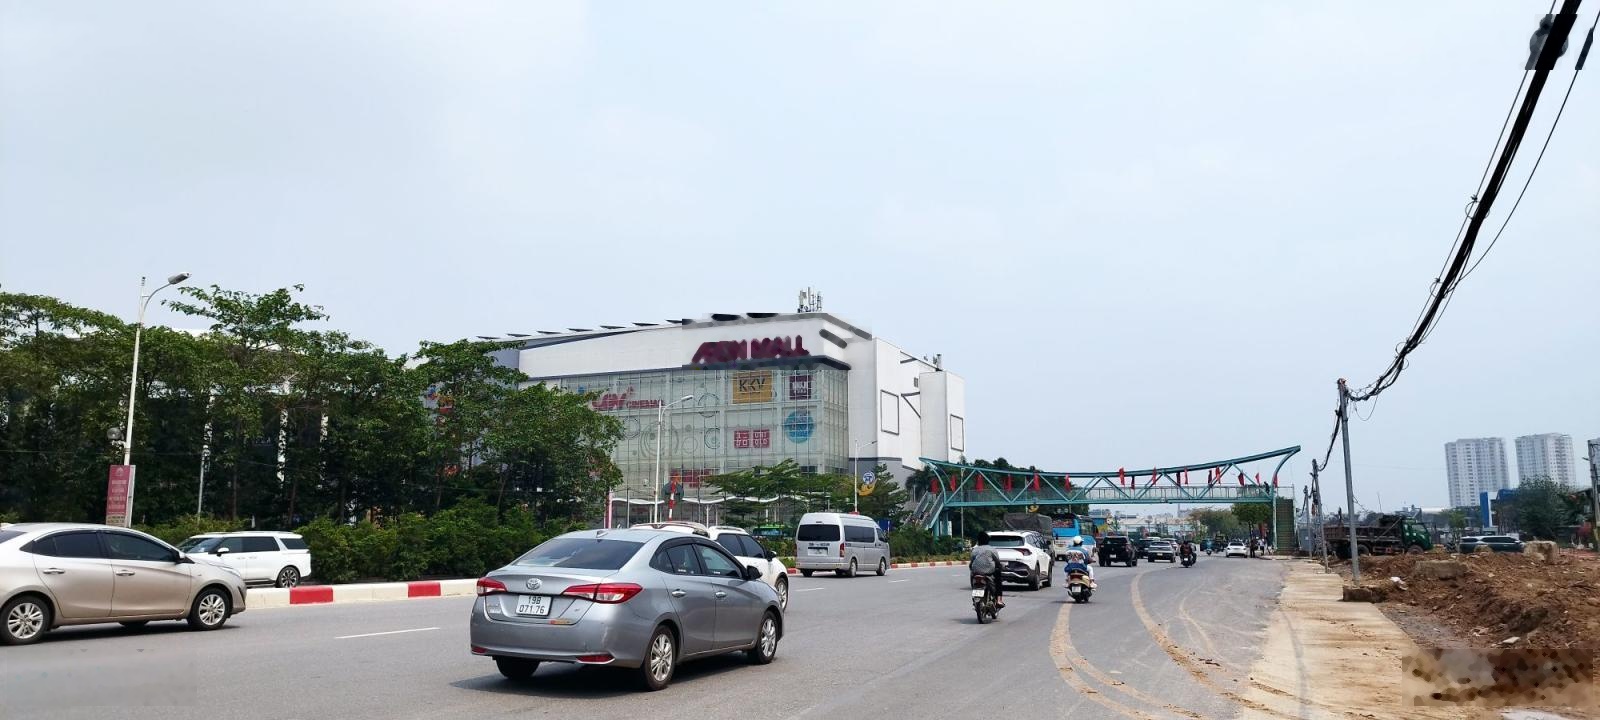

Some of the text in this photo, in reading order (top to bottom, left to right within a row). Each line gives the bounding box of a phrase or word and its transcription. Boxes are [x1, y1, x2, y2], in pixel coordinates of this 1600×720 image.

[739, 378, 766, 392] KKV
[528, 595, 542, 604] 19B
[519, 604, 546, 614] 071.76
